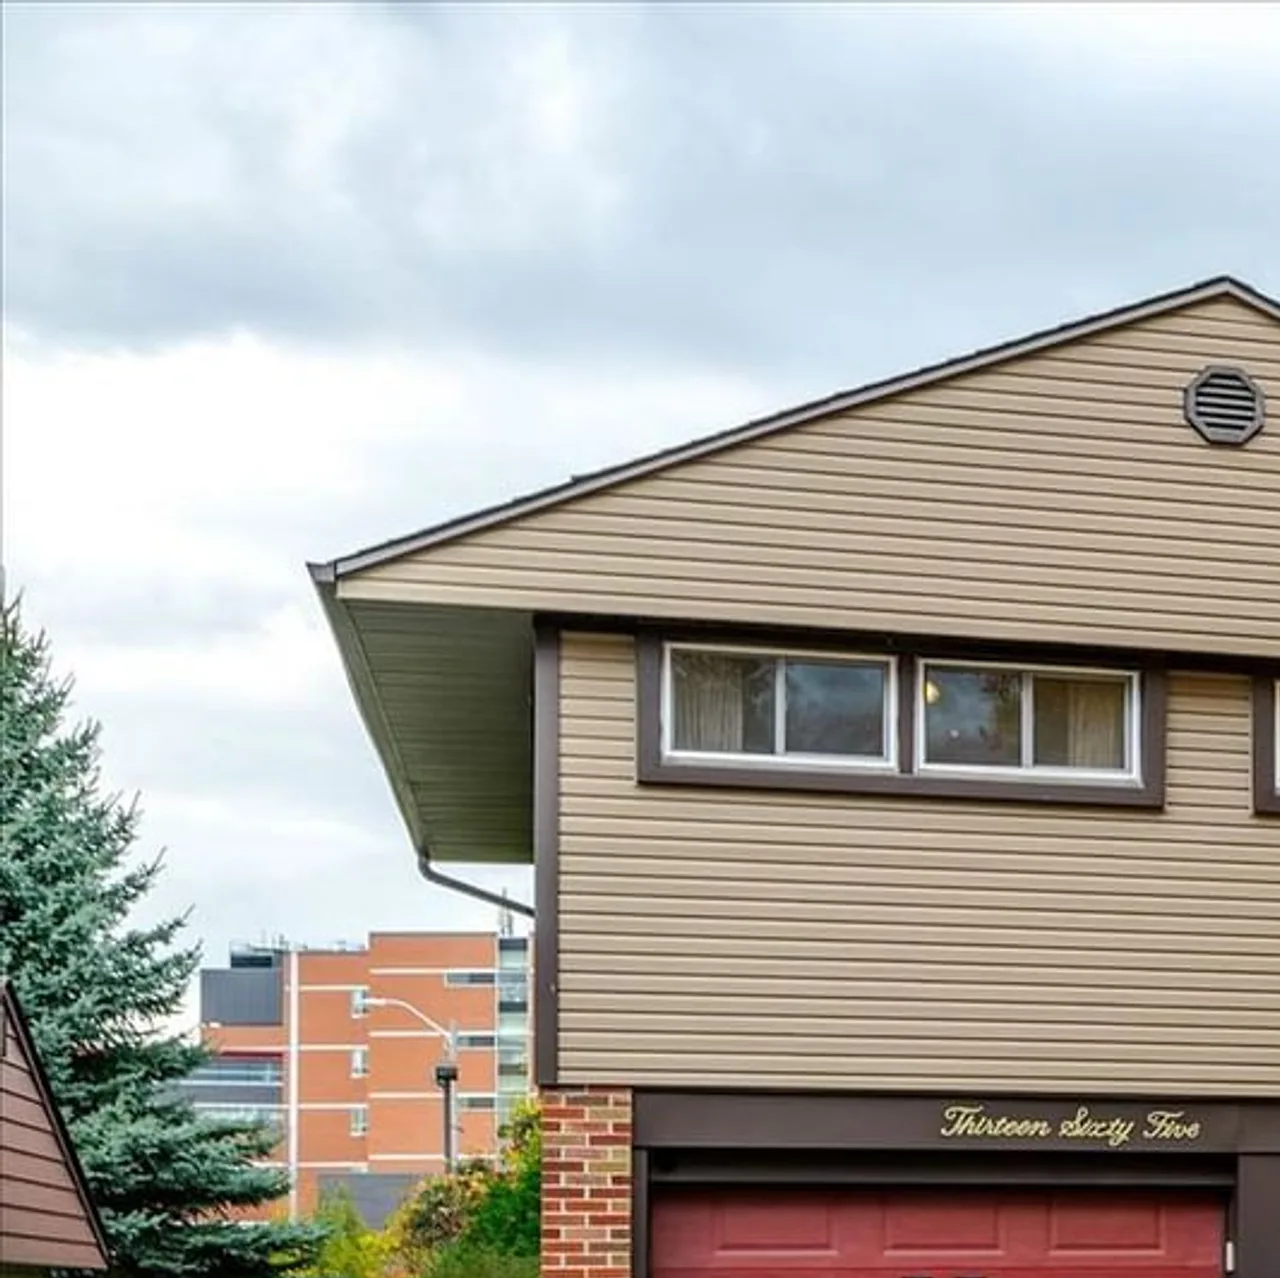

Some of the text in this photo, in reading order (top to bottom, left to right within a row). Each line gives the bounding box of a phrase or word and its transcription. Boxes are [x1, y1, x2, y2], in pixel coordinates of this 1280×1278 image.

[941, 1105, 1200, 1146] Thirteen Sixty Five
